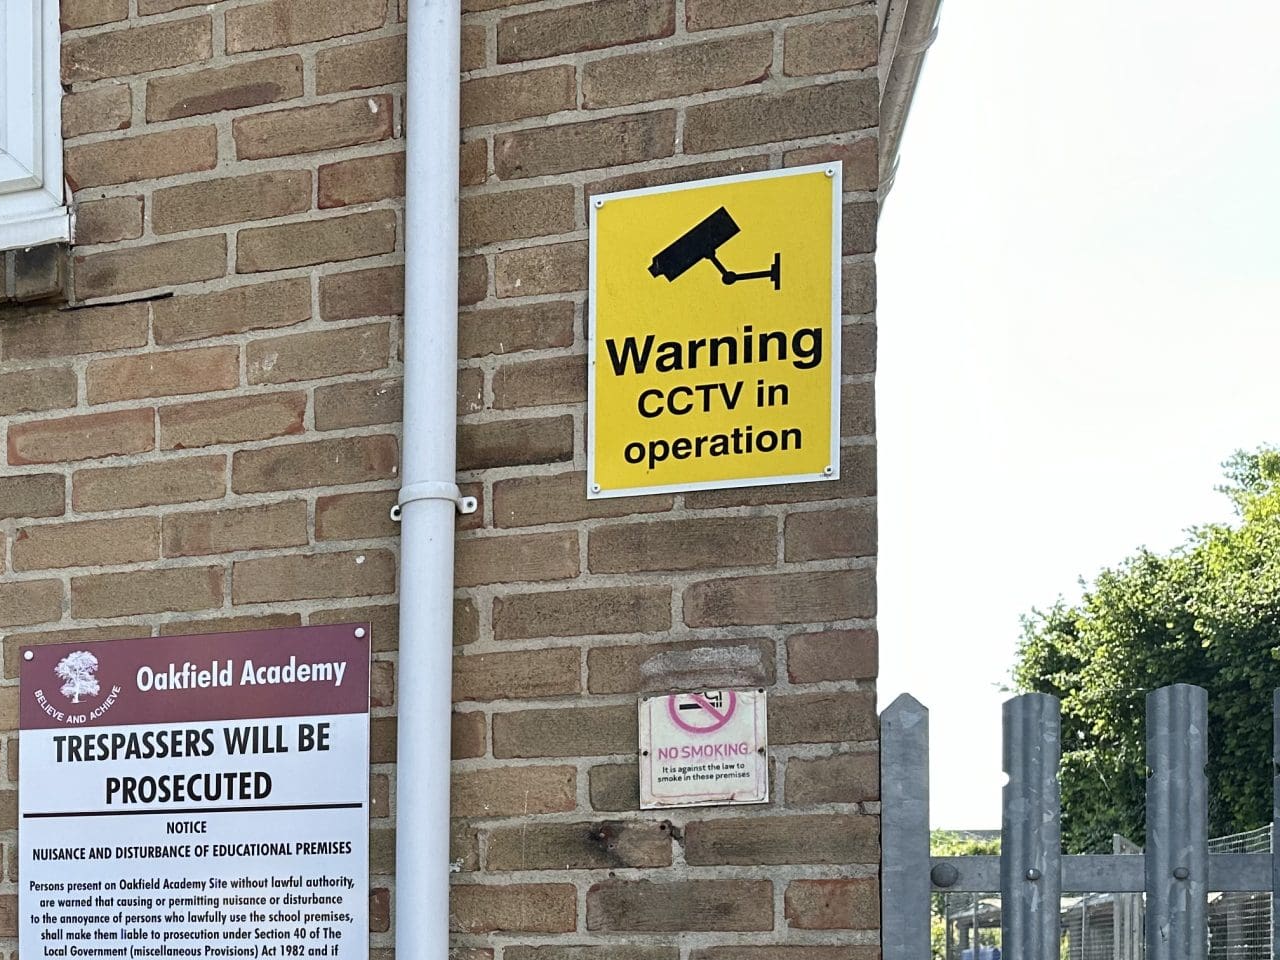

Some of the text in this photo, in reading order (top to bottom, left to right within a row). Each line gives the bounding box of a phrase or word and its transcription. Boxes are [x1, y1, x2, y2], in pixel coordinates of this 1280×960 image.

[605, 326, 823, 376] Warning
[638, 380, 789, 418] CCTV in
[624, 426, 802, 469] operation
[137, 656, 346, 692] Oakfield Academy
[34, 684, 121, 724] BELIEVE AND ACHIEVE
[53, 722, 331, 762] TRESPASSERS WILL BE
[658, 747, 678, 760] NO
[658, 774, 682, 782] smoke
[716, 771, 750, 781] premises
[678, 765, 705, 774] against
[106, 771, 272, 804] PROSECUTED
[166, 821, 207, 834] NOTICE
[32, 842, 352, 861] NUISANCE AND DISTURBANCE OF EDUCATIONAL PREMISES
[29, 876, 355, 893] Persons present on Oakfield Academy Site without lawful authority,
[40, 893, 343, 909] are warned that causing or permitting nuisance or disturbance
[31, 911, 353, 926] to the annoyance of persons who lawfully use the school premises,
[41, 928, 342, 942] shall make them liable to prosecution under Section 40 of The
[44, 944, 339, 959] Local Government (miscellaneous Provisions) Act 1982 and if
